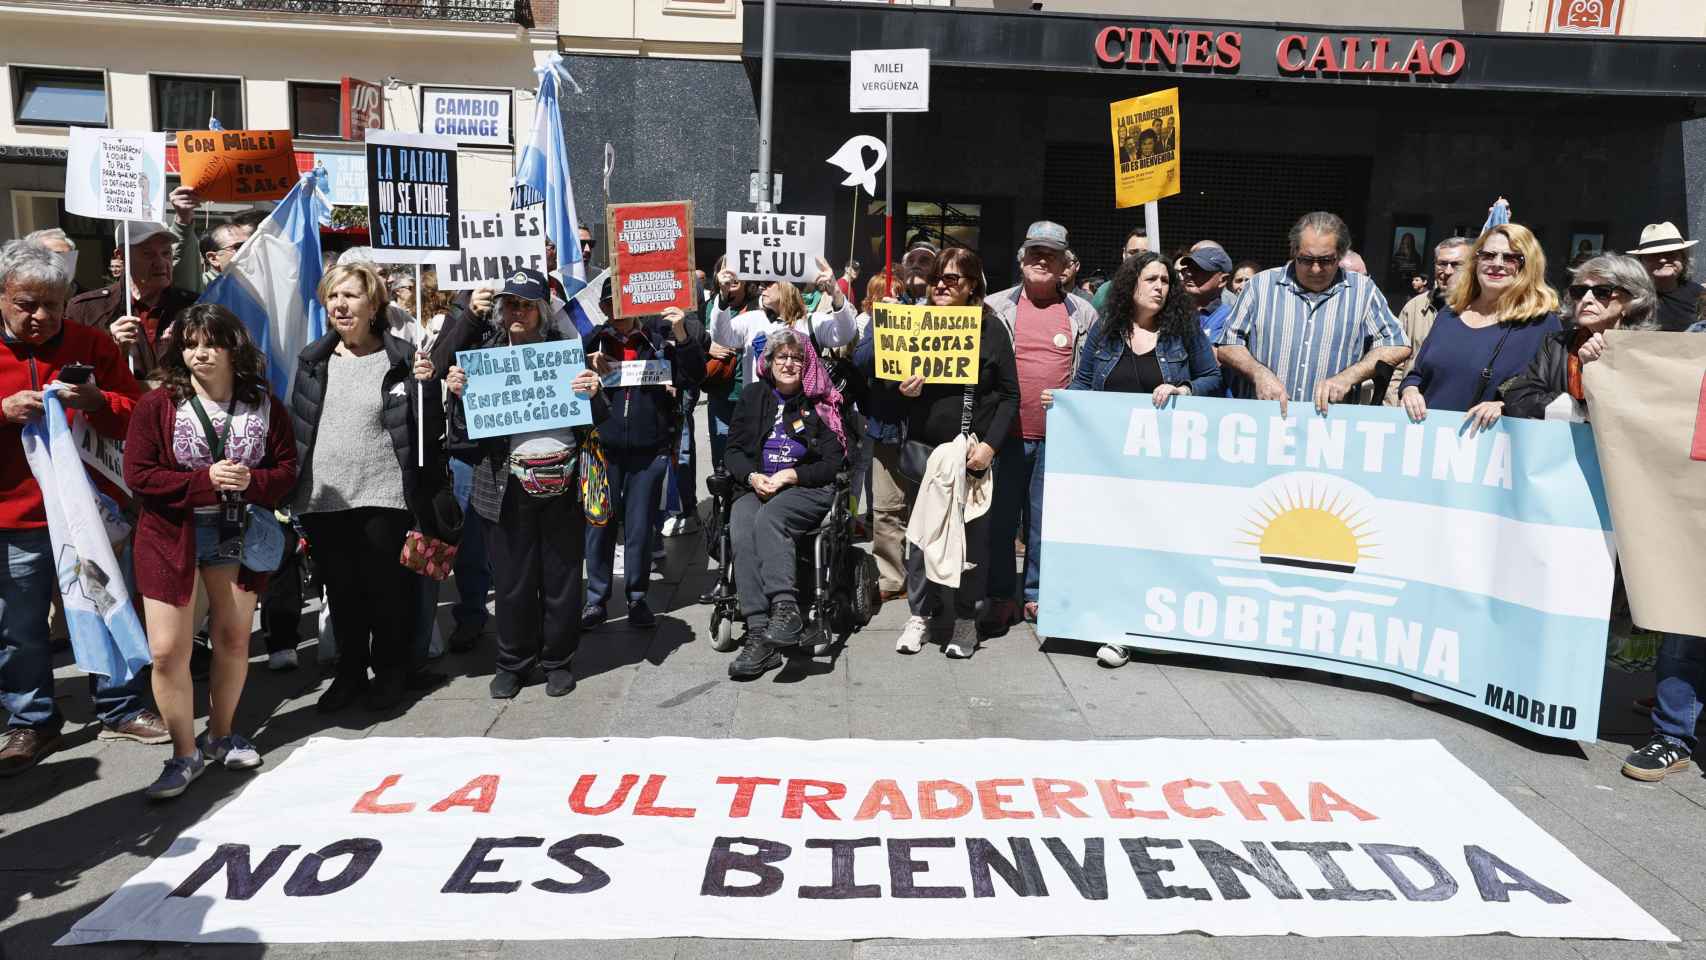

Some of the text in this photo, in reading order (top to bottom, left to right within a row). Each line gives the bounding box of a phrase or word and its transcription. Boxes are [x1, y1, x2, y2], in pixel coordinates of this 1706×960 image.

[1094, 26, 1467, 78] CINES CALLAO
[874, 63, 904, 73] MILEI
[862, 79, 919, 91] VERGÜENZA
[435, 97, 499, 118] CAMBIO
[435, 117, 499, 137] CHANGE
[16, 147, 68, 160] CALLAO
[377, 147, 393, 181] LA
[400, 149, 449, 184] PATRIA
[129, 172, 138, 180] NO
[1121, 161, 1130, 174] NO
[1131, 159, 1140, 171] ES
[378, 180, 395, 214] NO
[398, 182, 412, 214] SE
[379, 214, 450, 248] SE DEFIENDE
[514, 213, 540, 237] ES
[618, 230, 657, 242] ENTREGA
[658, 229, 671, 241] DE
[763, 237, 781, 248] ES
[738, 249, 806, 278] EE.UU
[622, 283, 634, 294] NO
[921, 311, 979, 331] ABASCAL
[880, 334, 975, 353] MASCOTAS
[522, 346, 585, 371] RECORTA
[882, 355, 971, 379] DEL PODER
[505, 369, 558, 387] A LOS
[466, 385, 556, 411] ENFERMOS
[473, 401, 581, 430] ONCOLÓGICOS
[1122, 408, 1513, 491] ARGENTINA
[1144, 586, 1461, 684] SOBERANA
[1484, 683, 1578, 731] MADRID
[352, 773, 1379, 824] LA ULTRADERECHA
[165, 832, 1573, 905] NO ES BIENVENIDA
